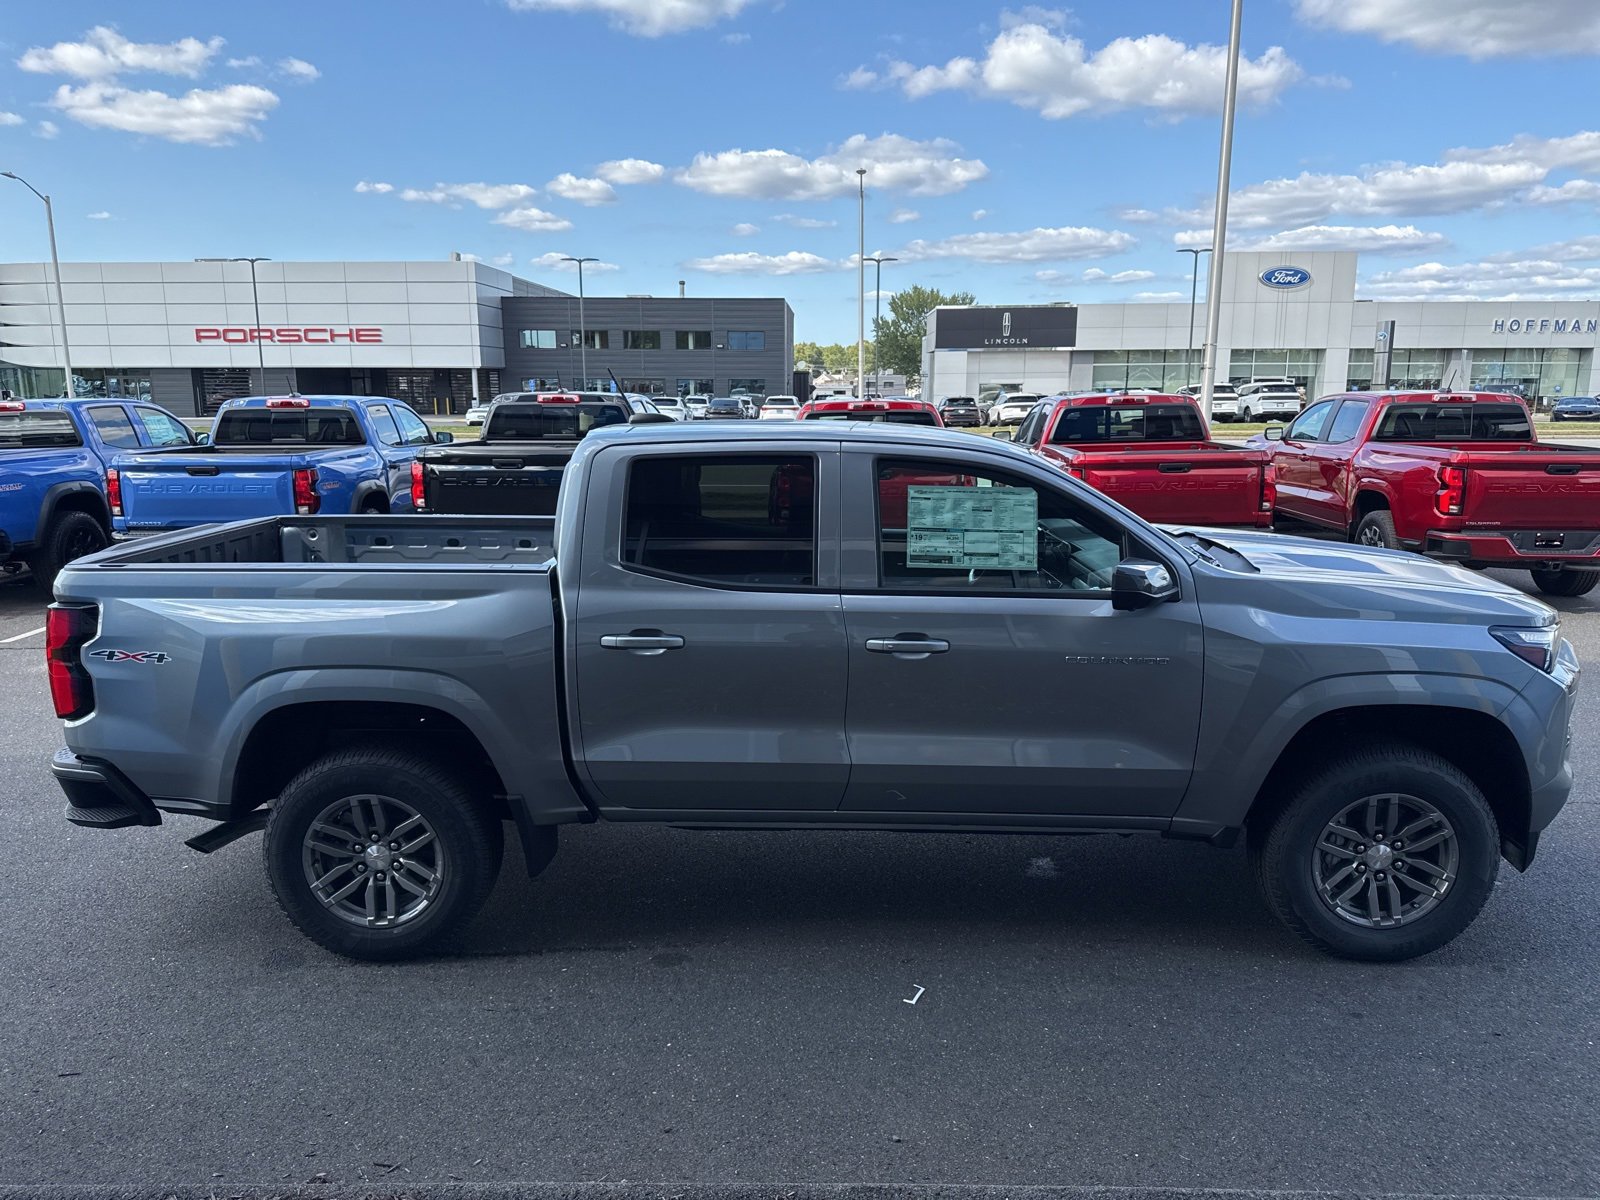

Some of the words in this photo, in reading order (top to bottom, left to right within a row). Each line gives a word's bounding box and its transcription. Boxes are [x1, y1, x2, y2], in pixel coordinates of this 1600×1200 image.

[1271, 270, 1301, 283] Ford
[1494, 319, 1598, 332] HOFFMAN
[195, 328, 383, 343] PORSCHE
[138, 485, 273, 494] CHEVROLET
[1104, 481, 1244, 492] CHEVROLET
